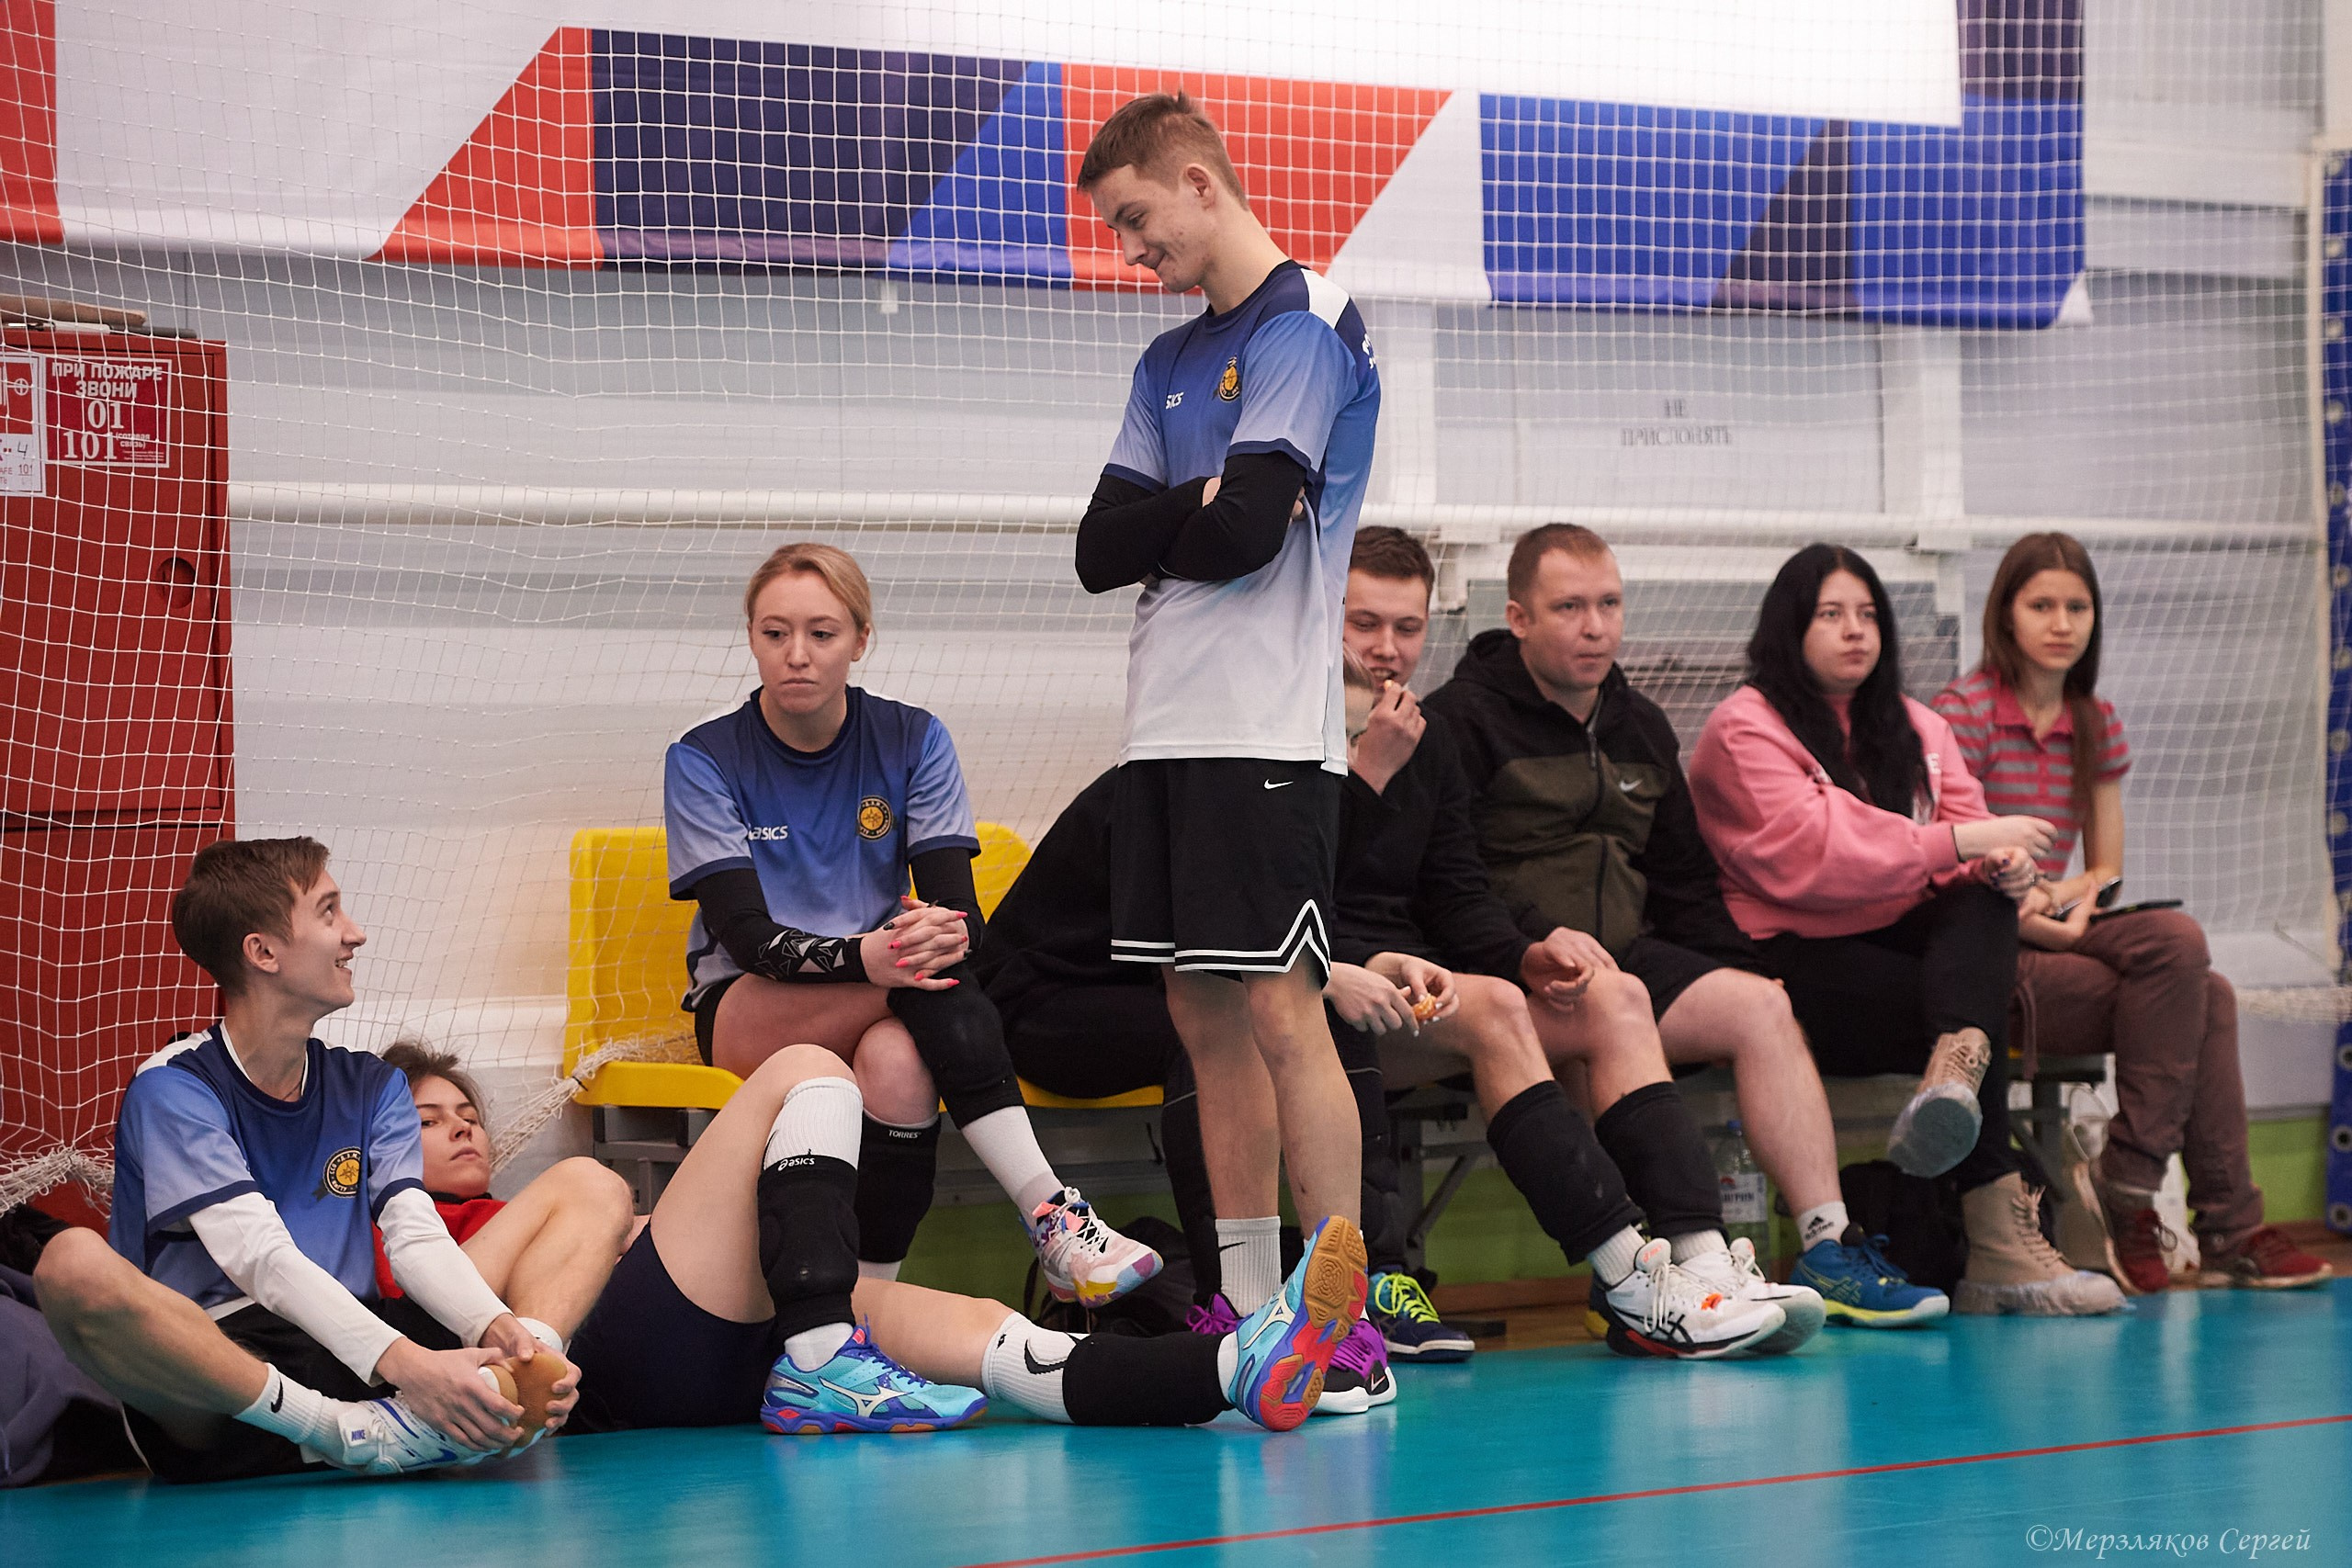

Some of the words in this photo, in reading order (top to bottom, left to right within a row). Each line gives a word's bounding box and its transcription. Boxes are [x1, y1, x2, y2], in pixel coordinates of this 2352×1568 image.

[51, 362, 85, 378] ПРИ
[91, 364, 163, 381] ПОЖАРЕ
[75, 380, 137, 398] ЗВОНИ
[87, 400, 124, 429] 01
[63, 431, 118, 459] 101
[1620, 425, 1732, 446] ПРИСЛОНЯТЬ
[888, 1129, 918, 1139] TORRES
[351, 1428, 366, 1441] NIKE
